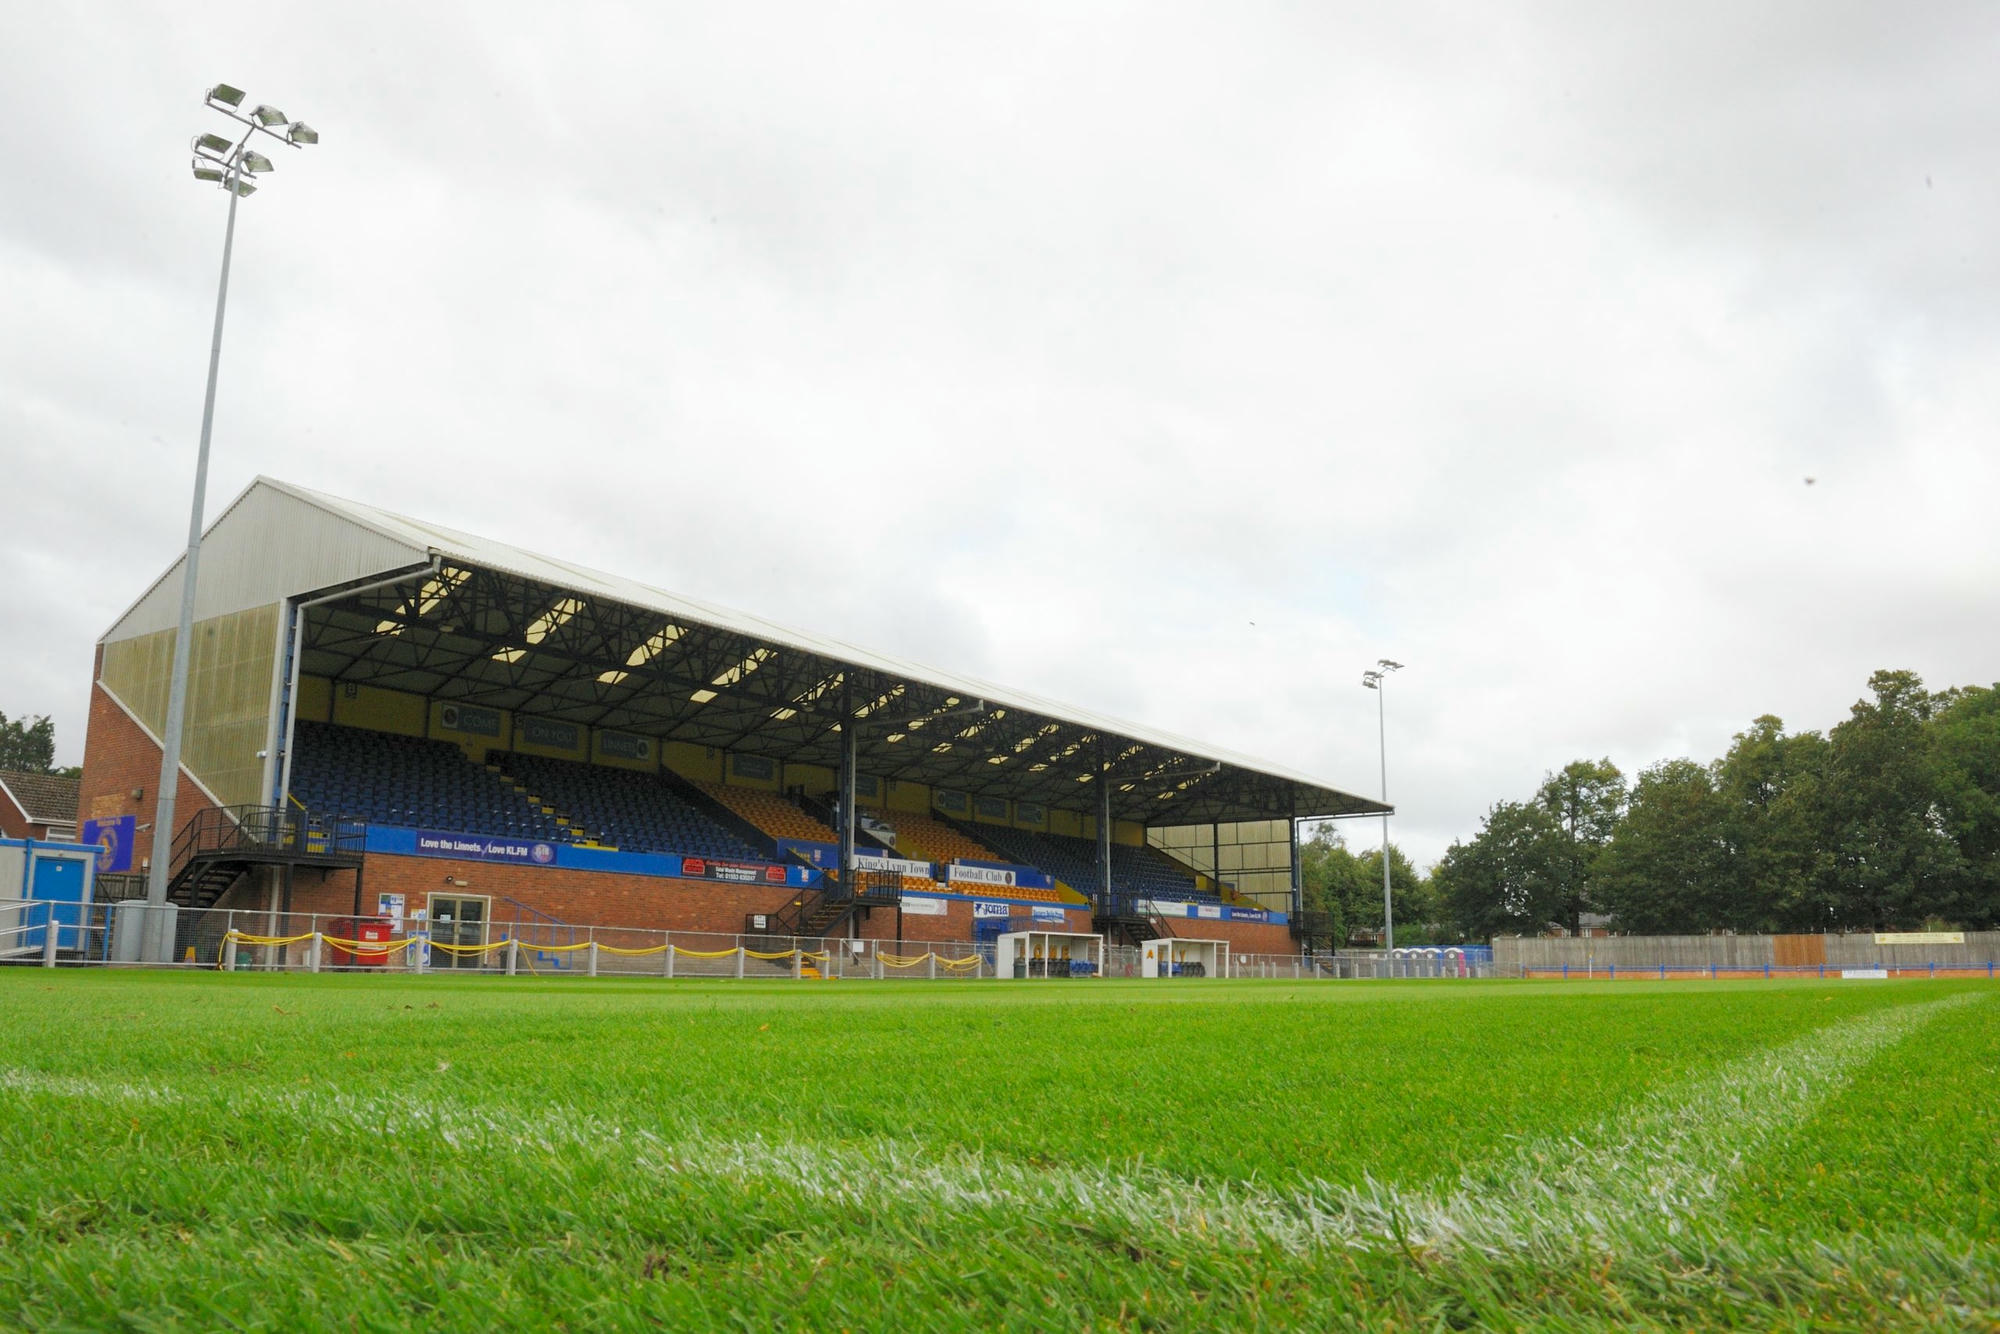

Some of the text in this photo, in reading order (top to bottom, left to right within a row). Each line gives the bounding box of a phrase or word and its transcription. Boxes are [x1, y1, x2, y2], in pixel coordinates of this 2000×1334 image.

[464, 715, 498, 730] COME
[421, 838, 439, 848] Love
[440, 839, 452, 850] the
[488, 843, 505, 854] Love
[858, 858, 884, 870] King's
[910, 863, 930, 875] Town
[954, 867, 1002, 882] Football Club
